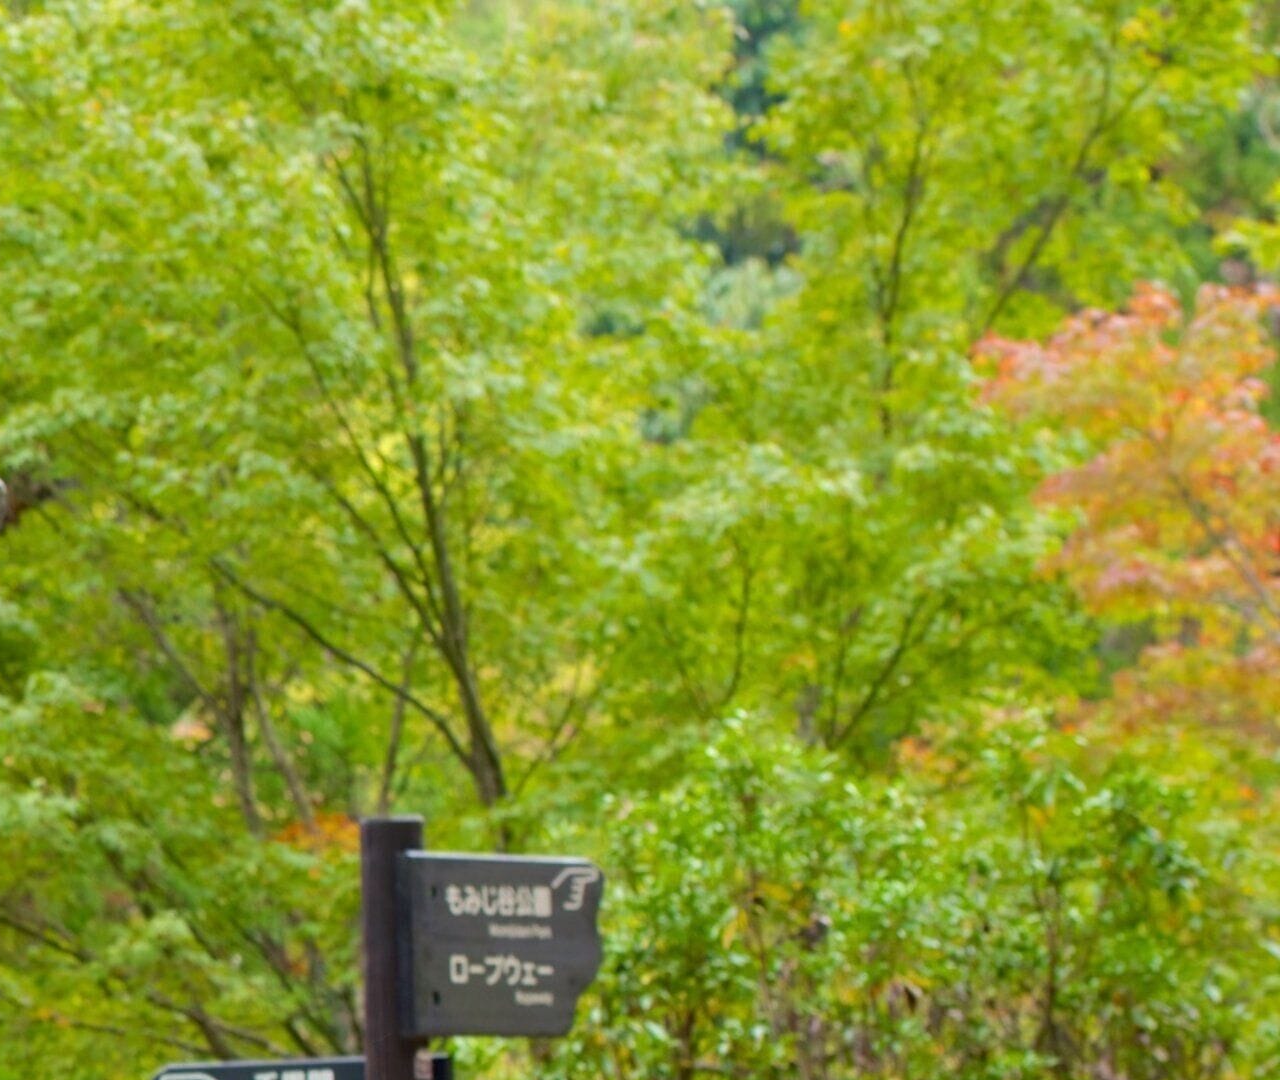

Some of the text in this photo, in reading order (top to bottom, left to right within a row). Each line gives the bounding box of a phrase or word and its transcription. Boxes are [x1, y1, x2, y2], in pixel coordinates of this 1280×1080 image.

[445, 884, 553, 917] もみじ谷公園
[449, 953, 555, 985] ロープウェー
